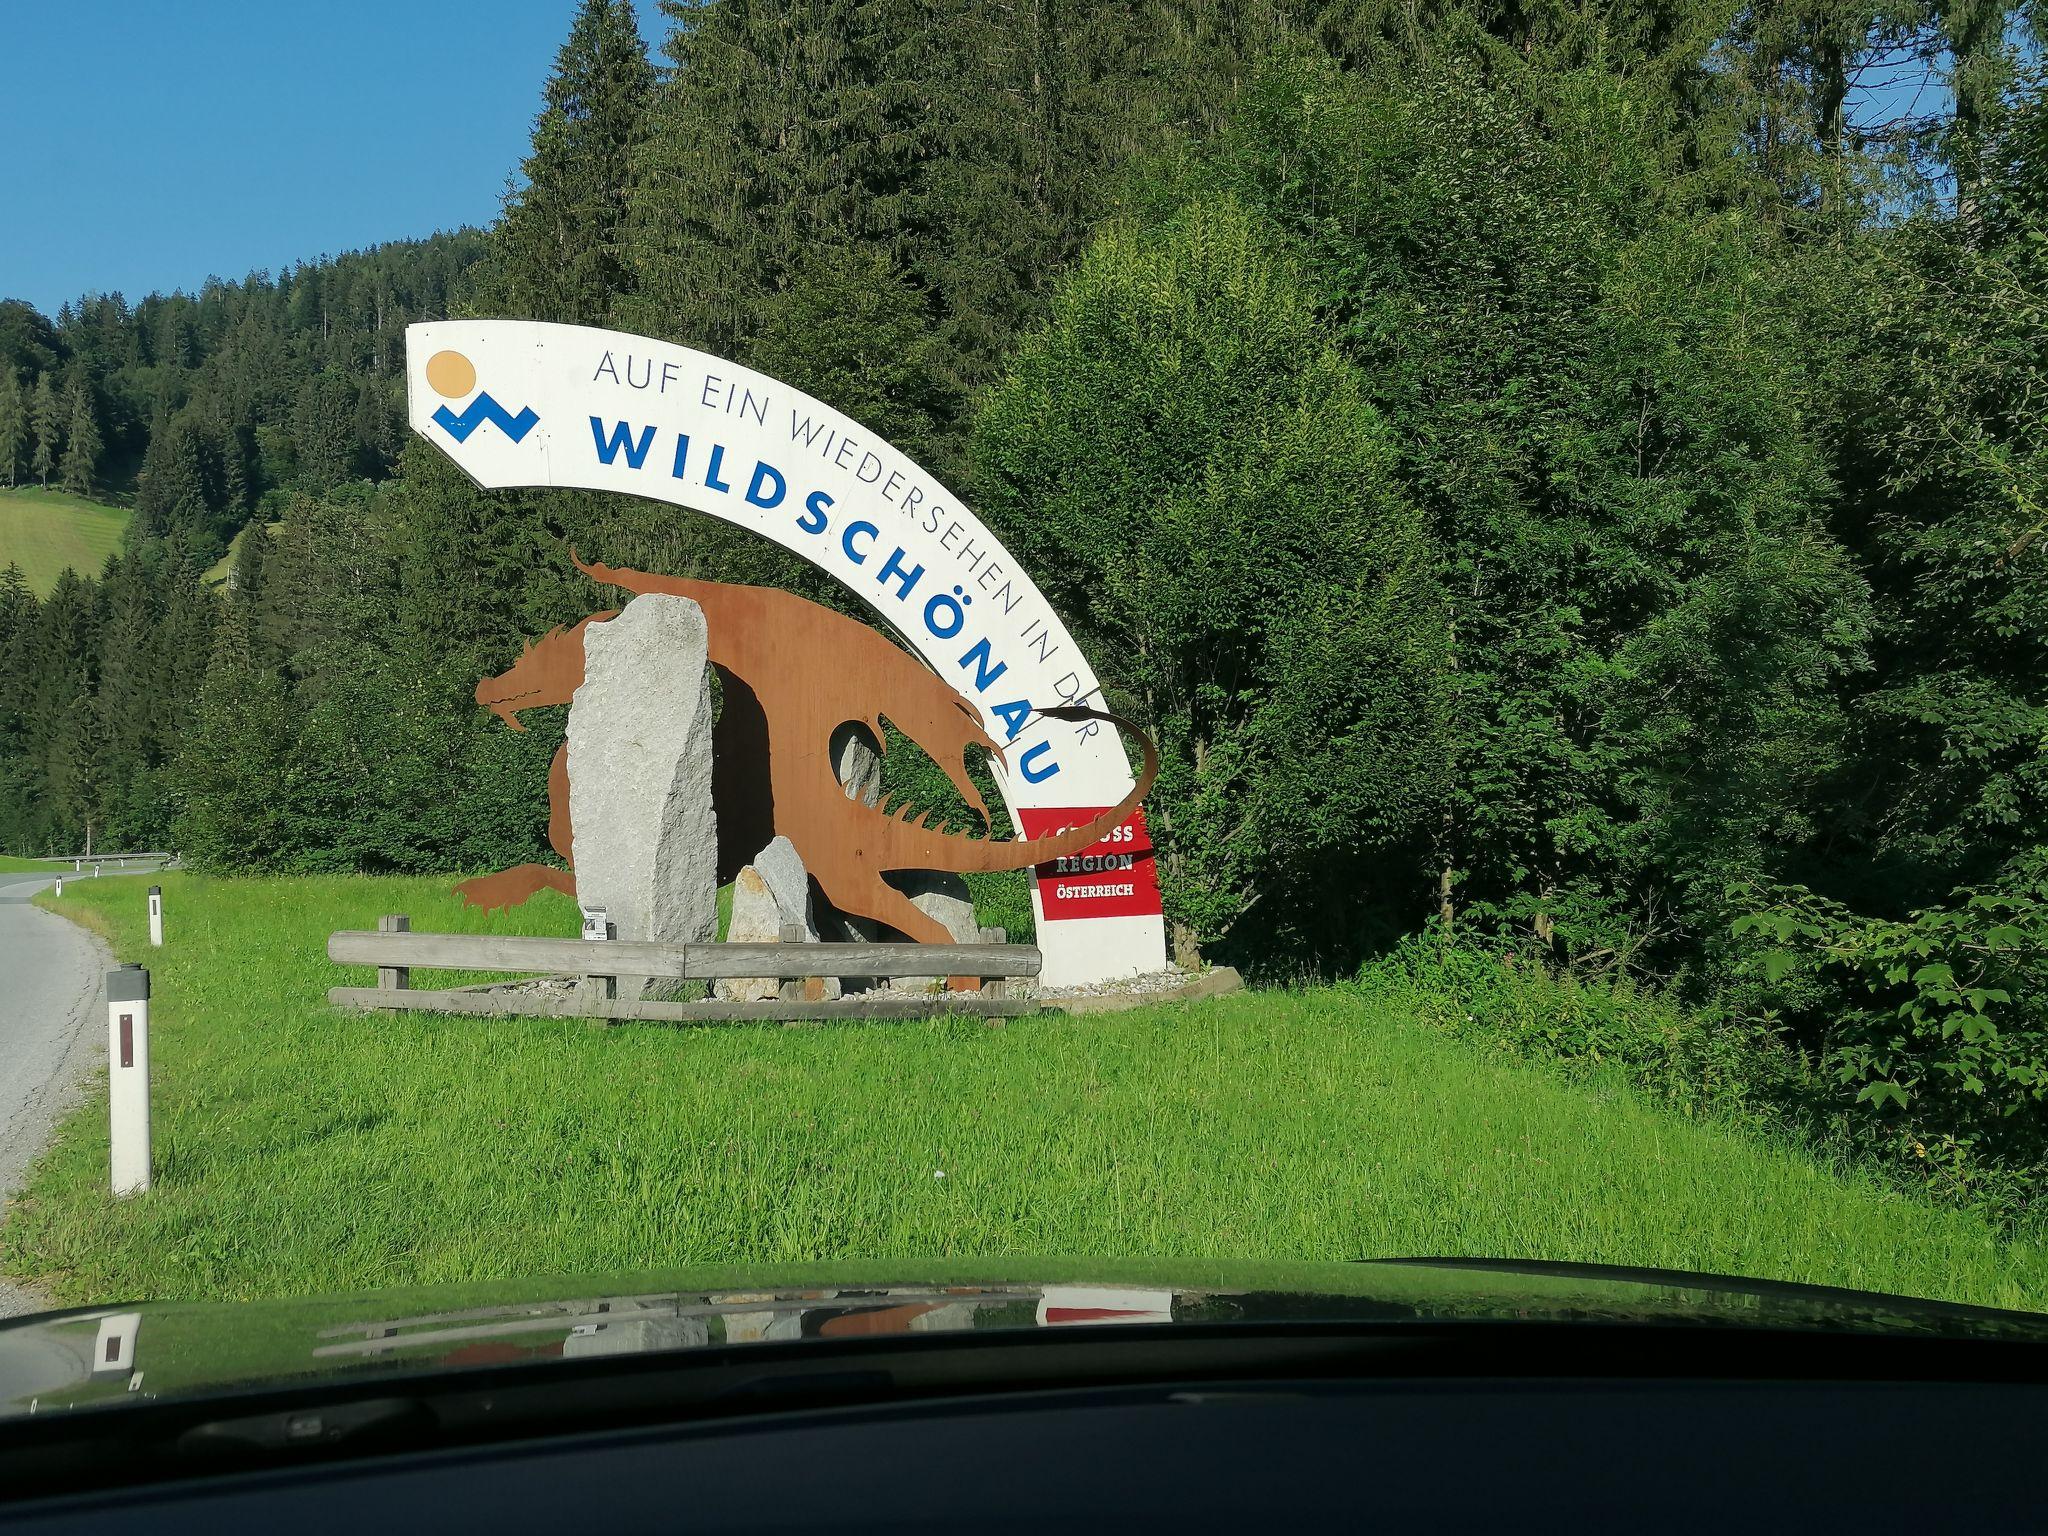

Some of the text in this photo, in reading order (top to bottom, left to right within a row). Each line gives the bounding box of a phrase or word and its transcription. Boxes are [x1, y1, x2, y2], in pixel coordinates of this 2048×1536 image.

[589, 415, 1060, 784] WILDSCHÖNAU
[593, 350, 1099, 746] AUF EIN WIEDERSEHEN IN DR
[1056, 854, 1134, 873] REGION
[1056, 883, 1134, 899] ÖSTERREICH
